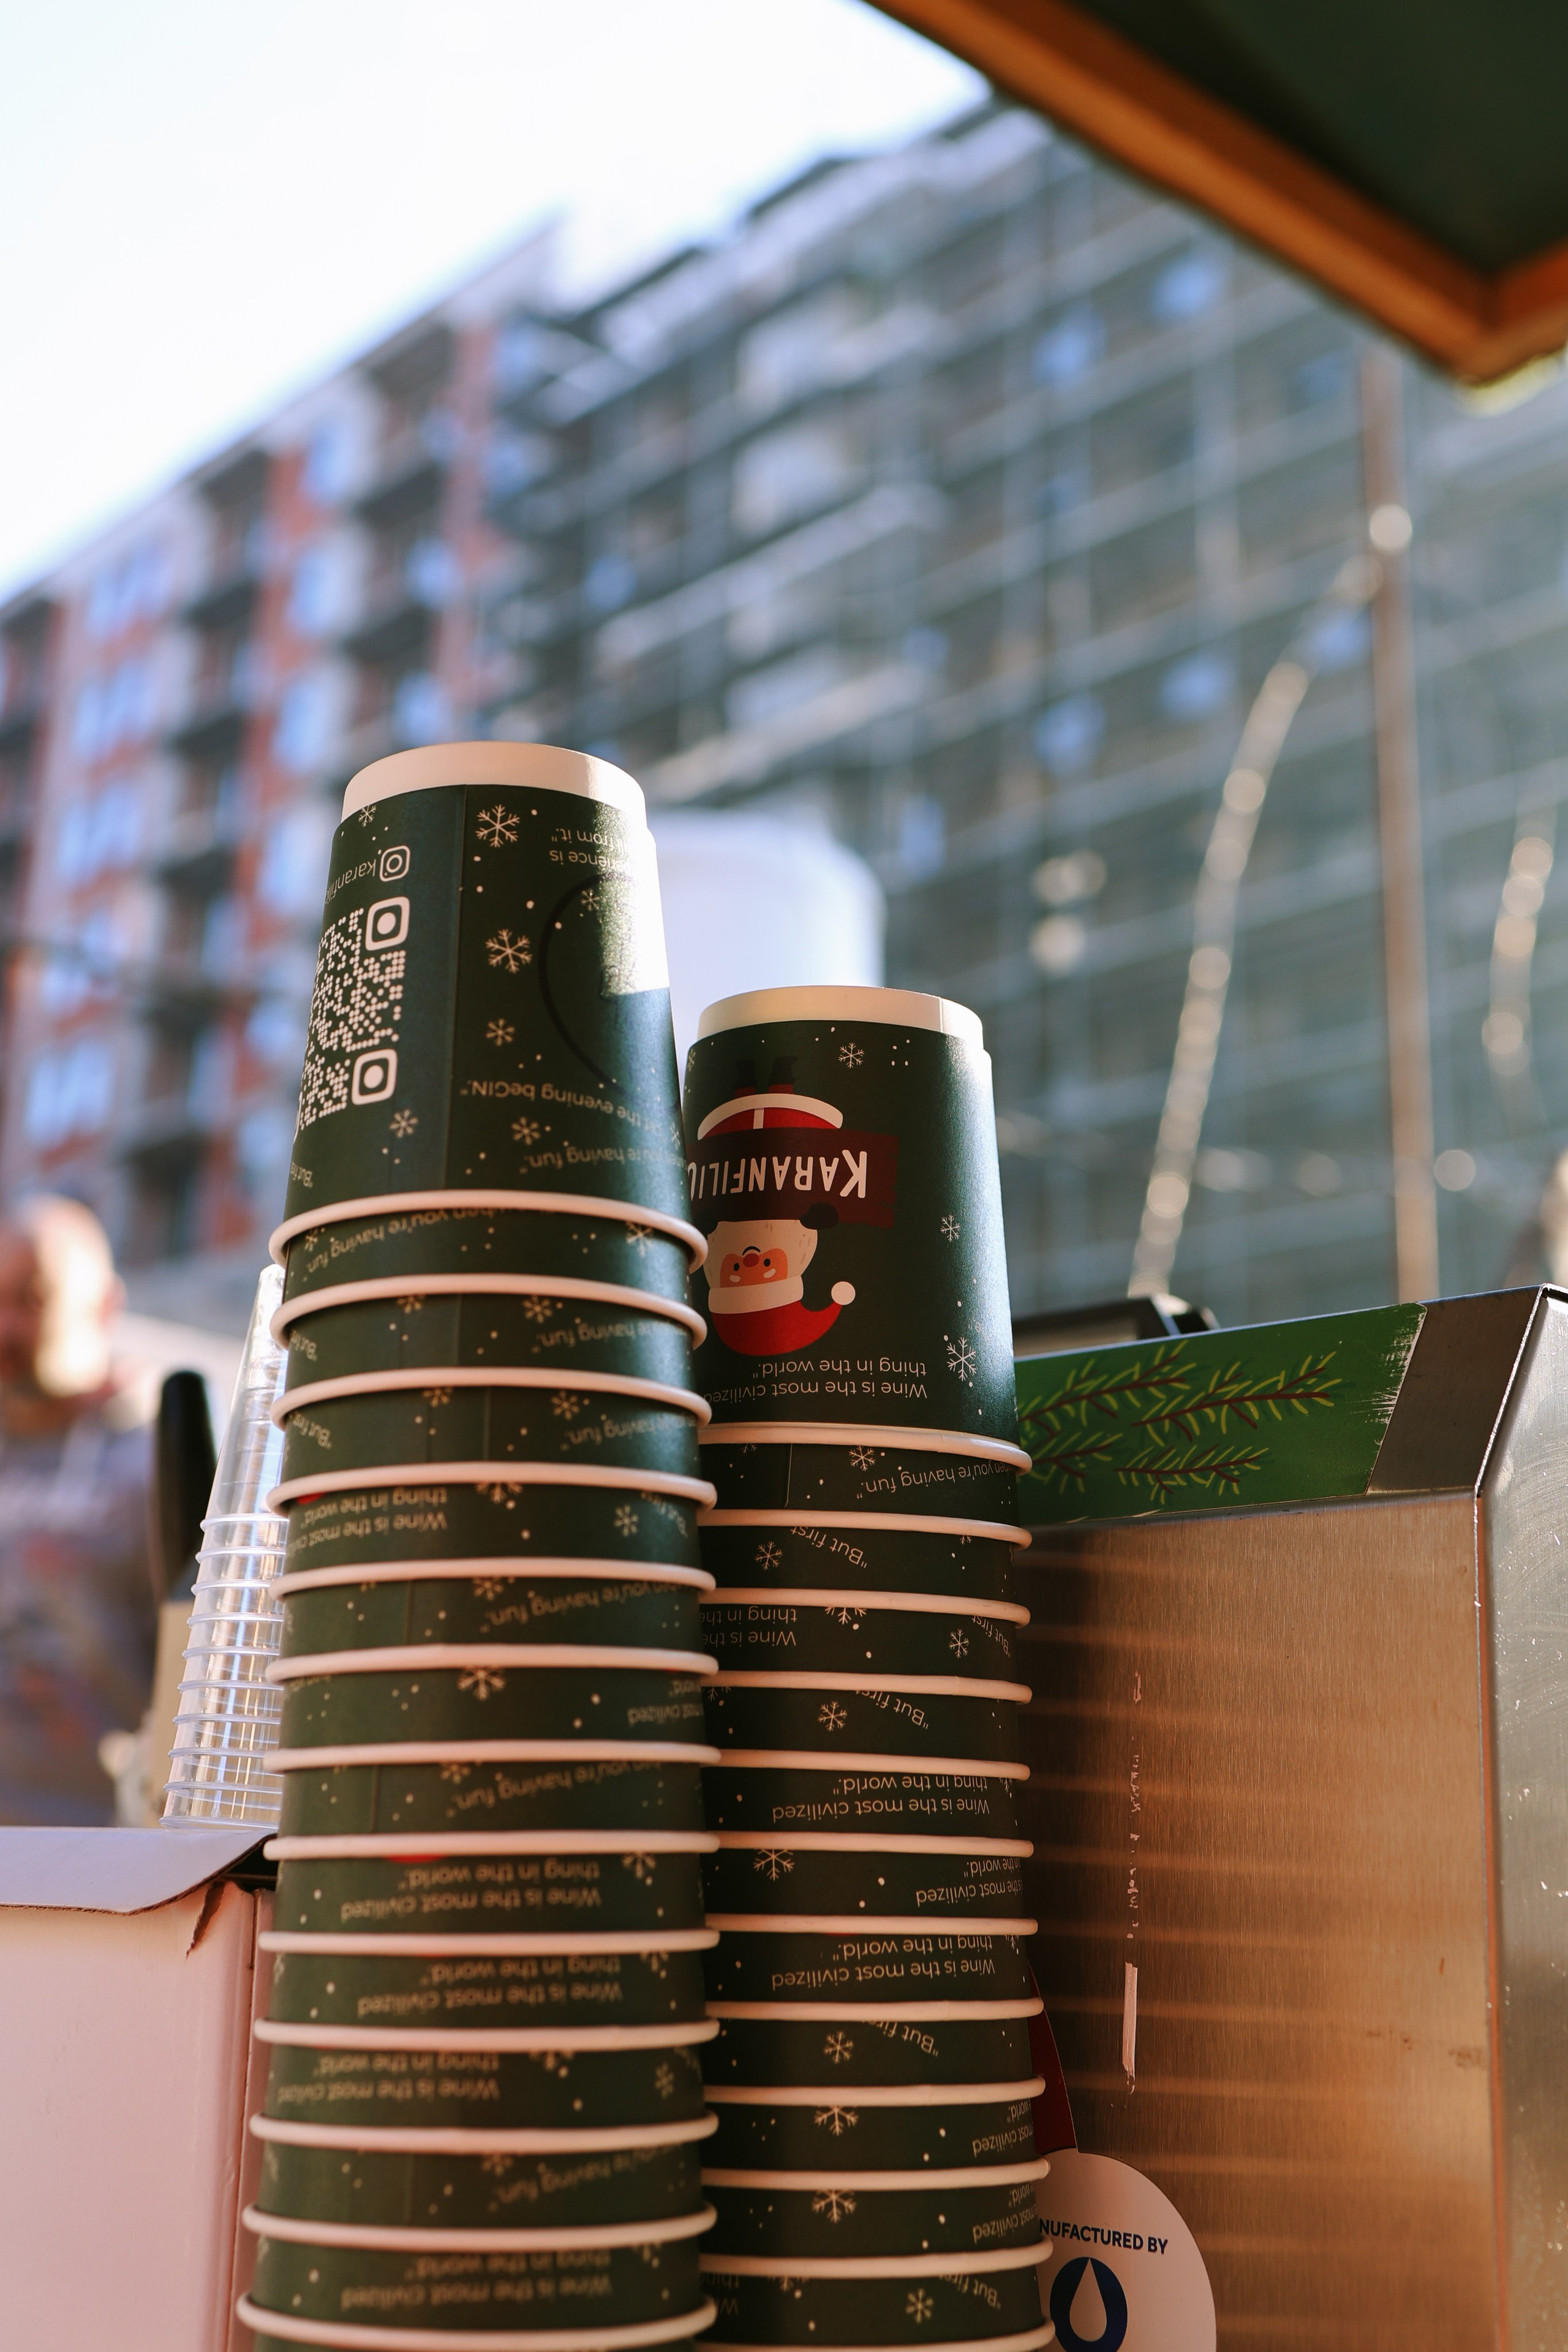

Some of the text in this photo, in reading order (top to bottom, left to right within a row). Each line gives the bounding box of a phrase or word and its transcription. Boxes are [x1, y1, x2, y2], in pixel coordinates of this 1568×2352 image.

[552, 828, 572, 843] it."
[549, 850, 564, 865] is
[461, 1080, 535, 1101] beGIN."
[529, 1083, 613, 1115] evening
[617, 1106, 641, 1127] the
[519, 1152, 562, 1175] fun."
[564, 1146, 625, 1165] having
[330, 1226, 385, 1257] having
[532, 1329, 576, 1354] fun."
[577, 1322, 636, 1343] having
[753, 1357, 927, 1379] thing in the world."
[772, 1382, 818, 1398] most
[825, 1381, 857, 1396] the
[861, 1381, 875, 1397] is
[881, 1382, 927, 1399] Wine
[561, 1427, 602, 1452] fun."
[603, 1420, 656, 1439] having
[901, 1471, 955, 1488] having
[959, 1460, 993, 1480] you're
[392, 1487, 447, 1509] thing
[857, 1477, 897, 1499] fun."
[339, 1494, 368, 1515] the
[371, 1493, 388, 1512] in
[309, 1511, 448, 1547] Wine is the most
[830, 1539, 868, 1569] "But
[530, 1596, 600, 1616] having
[728, 1610, 741, 1625] in
[747, 1605, 797, 1624] thing
[480, 1605, 528, 1634] fun."
[730, 1632, 742, 1648] is
[748, 1630, 796, 1647] Wine
[995, 1629, 1011, 1659] "But
[894, 1698, 929, 1730] "But
[498, 1771, 573, 1800] having
[834, 1776, 988, 1795] thing in the world."
[447, 1787, 496, 1819] fun."
[773, 1798, 990, 1824] Wine is the most civilized
[474, 1863, 513, 1887] the
[516, 1862, 539, 1885] in
[543, 1857, 600, 1883] thing
[964, 1860, 1001, 1878] world."
[916, 1886, 976, 1908] civilized
[979, 1882, 1006, 1898] most
[340, 1887, 601, 1924] Wine is the most civilized
[834, 1936, 993, 1961] thing in the world."
[499, 1959, 538, 1981] the
[541, 1959, 562, 1980] in
[567, 1956, 621, 1980] thing
[773, 1959, 996, 1991] Wine is the most civilized
[357, 1983, 622, 2019] Wine is the most civilized
[902, 2025, 939, 2057] "But
[371, 2053, 408, 2076] the
[411, 2053, 434, 2077] in
[437, 2052, 500, 2075] thing
[328, 2081, 375, 2103] most
[377, 2079, 413, 2103] the
[416, 2077, 435, 2104] is
[439, 2077, 500, 2102] Wine
[972, 2129, 1017, 2158] civilized
[973, 2214, 1018, 2245] civilized
[1039, 2218, 1168, 2255] NUFACTURED BY
[487, 2254, 528, 2276] the
[430, 2282, 491, 2307] most
[492, 2278, 535, 2306] the
[537, 2277, 556, 2302] is
[559, 2275, 612, 2297] Wine
